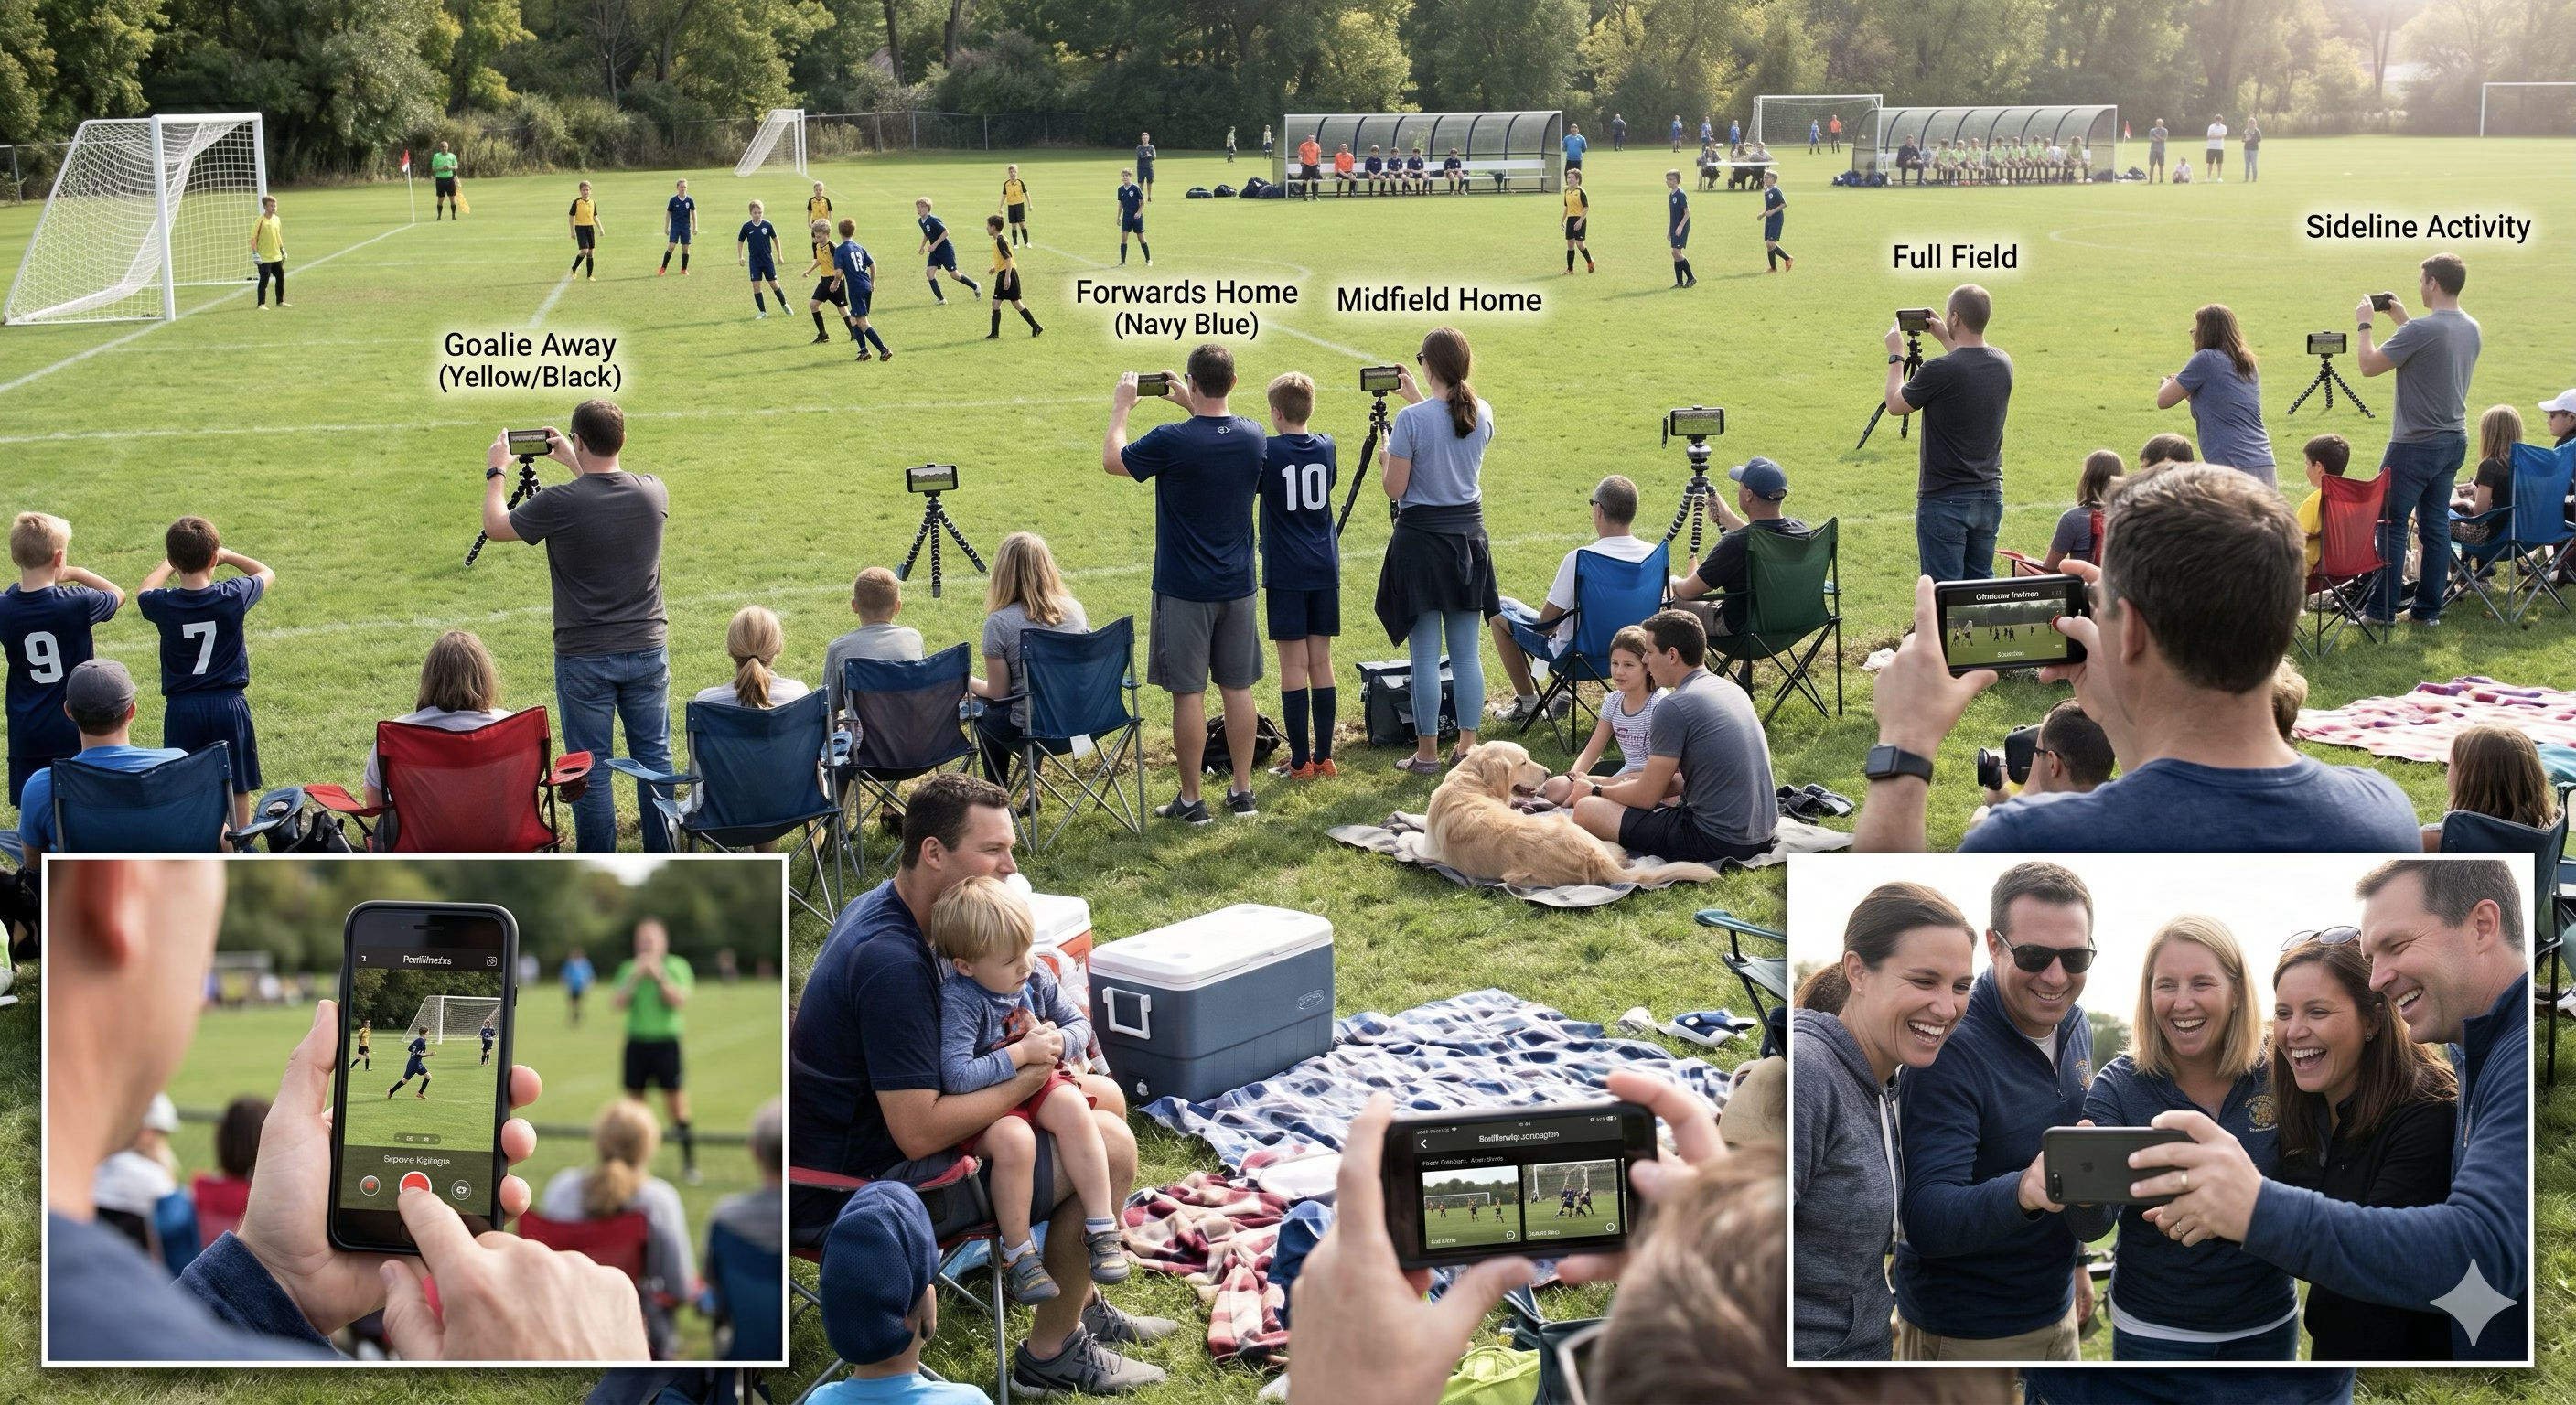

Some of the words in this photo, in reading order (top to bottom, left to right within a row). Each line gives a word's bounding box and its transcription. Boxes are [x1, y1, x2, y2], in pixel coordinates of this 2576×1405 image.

[1282, 463, 1327, 511] 10
[24, 631, 64, 684] 9
[182, 620, 217, 675] 7
